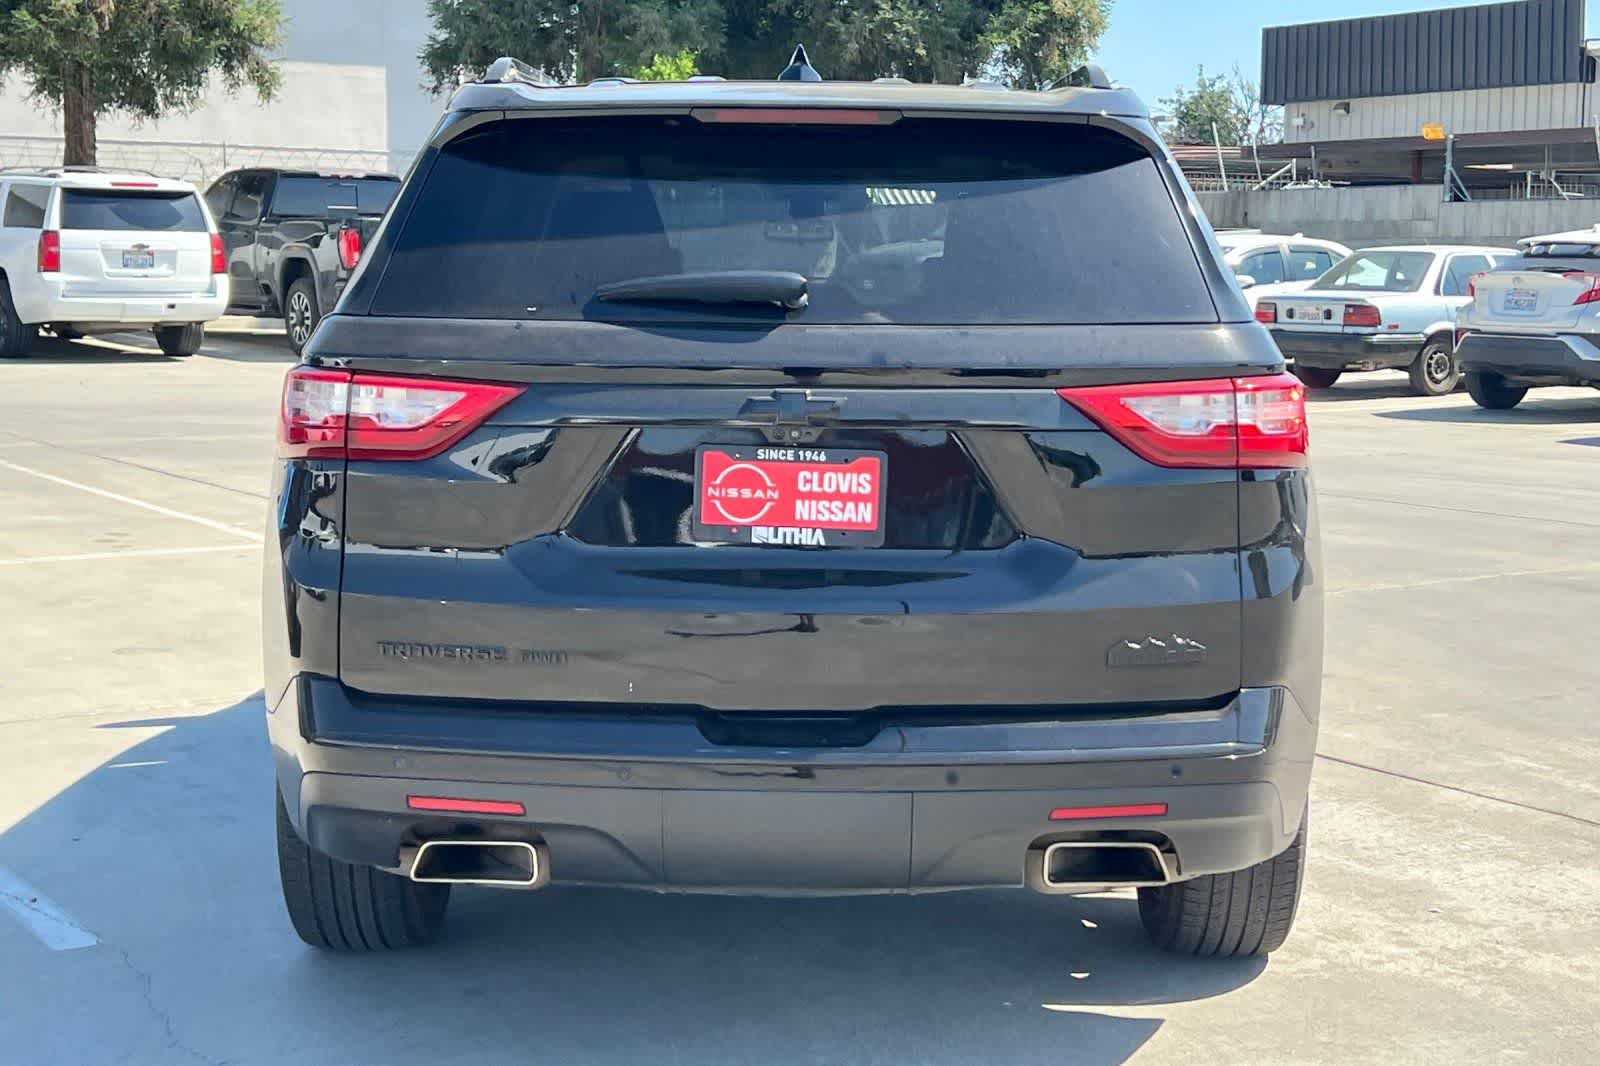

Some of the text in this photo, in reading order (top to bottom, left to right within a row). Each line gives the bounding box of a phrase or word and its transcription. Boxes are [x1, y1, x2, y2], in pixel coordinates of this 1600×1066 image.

[756, 449, 826, 462] SINCE 1946
[707, 486, 779, 499] NISSAN
[797, 470, 872, 494] CLOVIS
[795, 499, 872, 523] NISSAN
[767, 526, 826, 546] LITHIA
[377, 640, 507, 664] TRAVERSE
